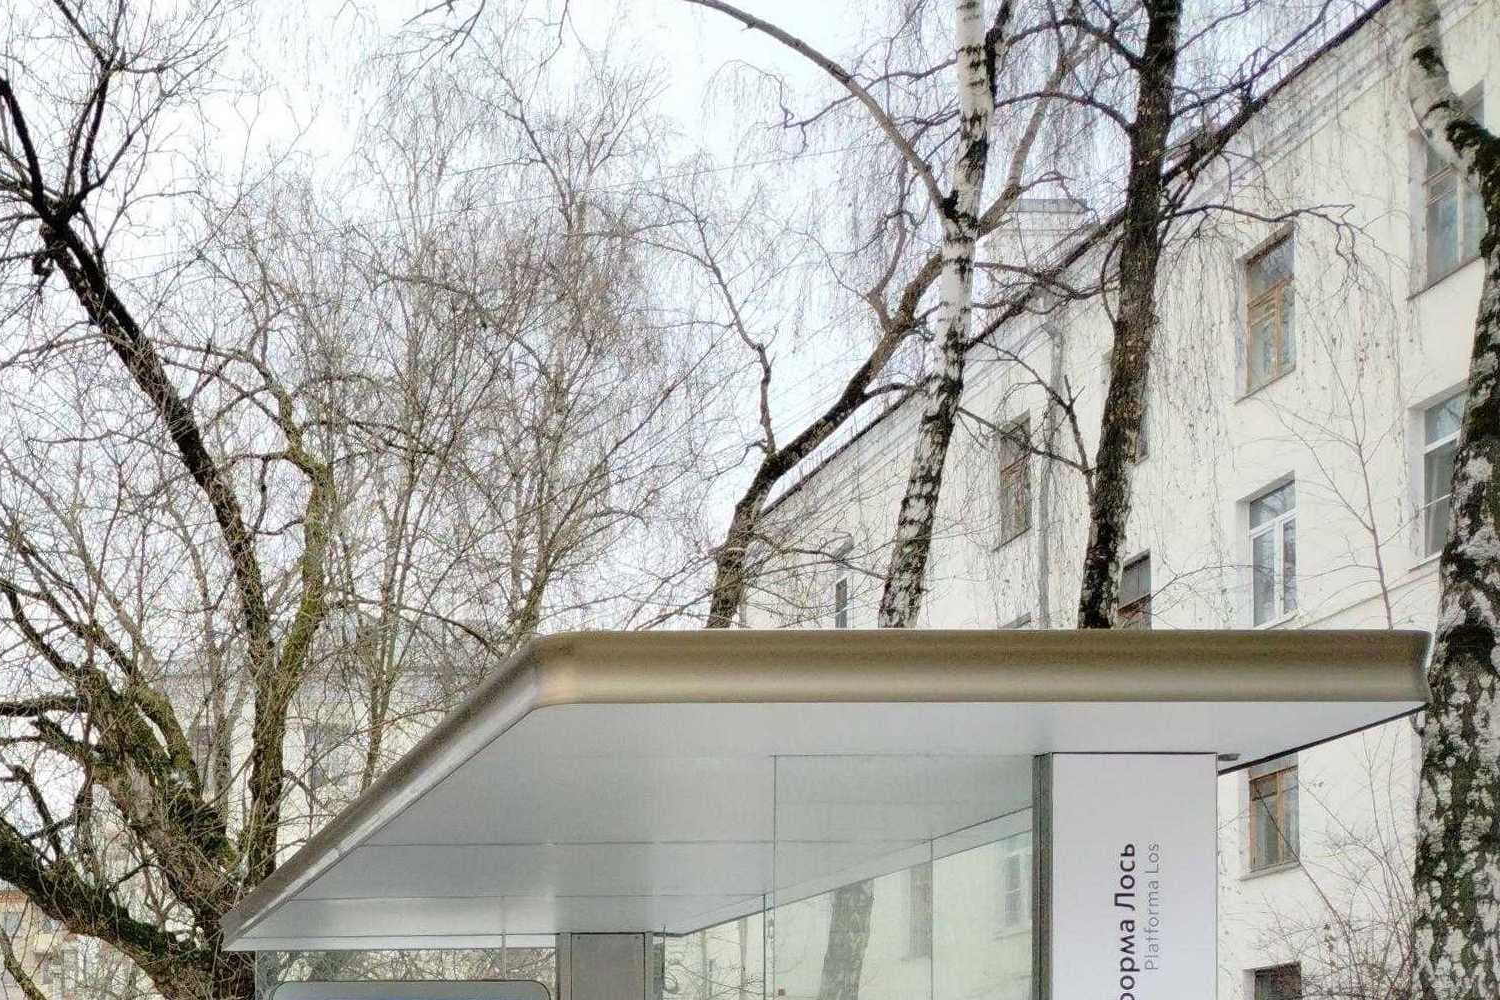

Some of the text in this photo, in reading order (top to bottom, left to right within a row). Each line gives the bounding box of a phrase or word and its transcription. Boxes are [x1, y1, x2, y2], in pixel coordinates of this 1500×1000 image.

[1113, 843, 1136, 912] Лось
[1144, 843, 1160, 971] Platforma Los
